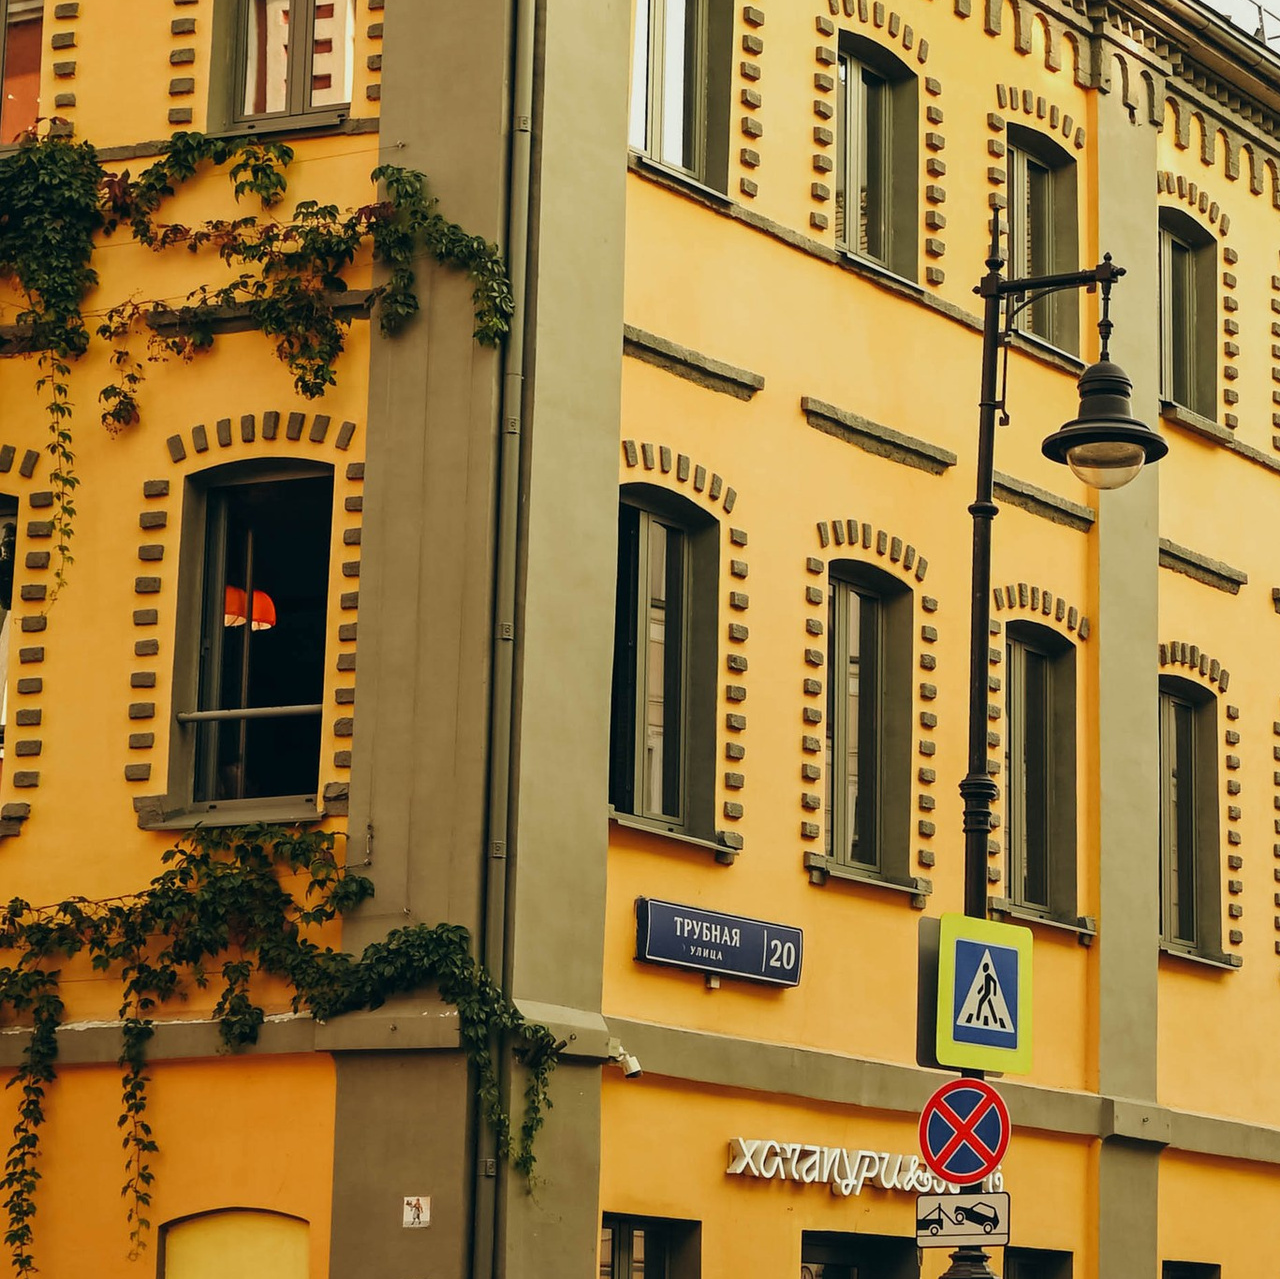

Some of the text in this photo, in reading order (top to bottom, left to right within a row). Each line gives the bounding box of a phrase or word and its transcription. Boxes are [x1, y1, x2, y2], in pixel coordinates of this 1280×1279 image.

[673, 916, 741, 948] ТРУБНАЯ
[690, 945, 723, 961] УЛИЦА
[769, 939, 796, 970] 20
